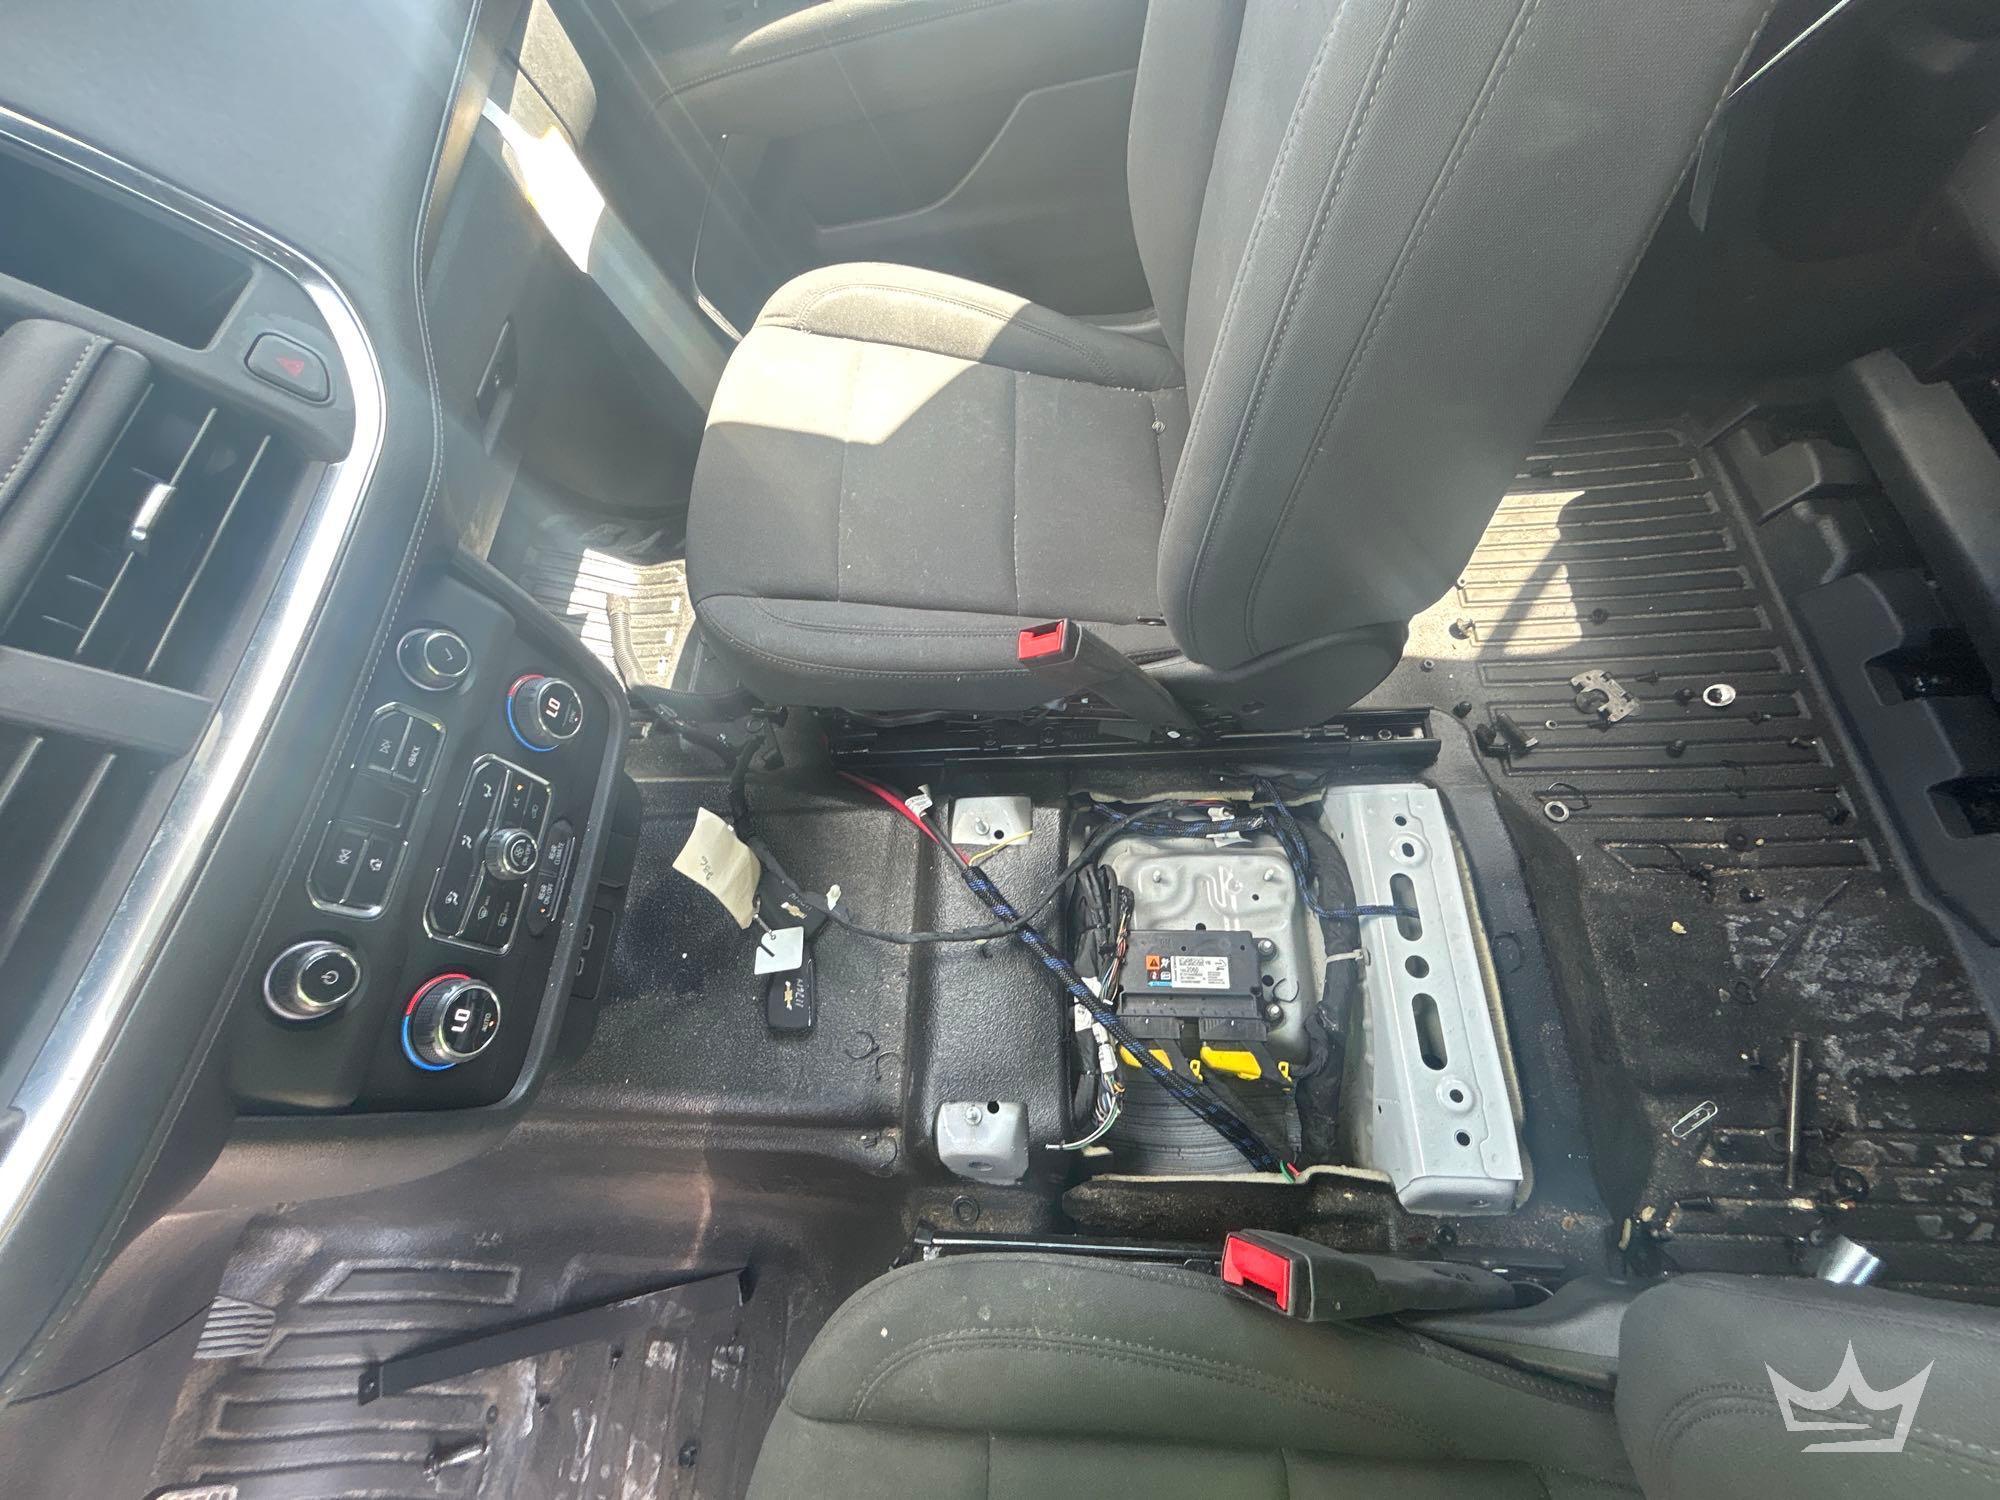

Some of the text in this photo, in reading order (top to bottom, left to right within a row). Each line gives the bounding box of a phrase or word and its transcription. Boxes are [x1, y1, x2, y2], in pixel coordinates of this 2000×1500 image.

[546, 697, 561, 718] LO
[451, 1008, 471, 1032] LO
[481, 1012, 492, 1032] AUTO
